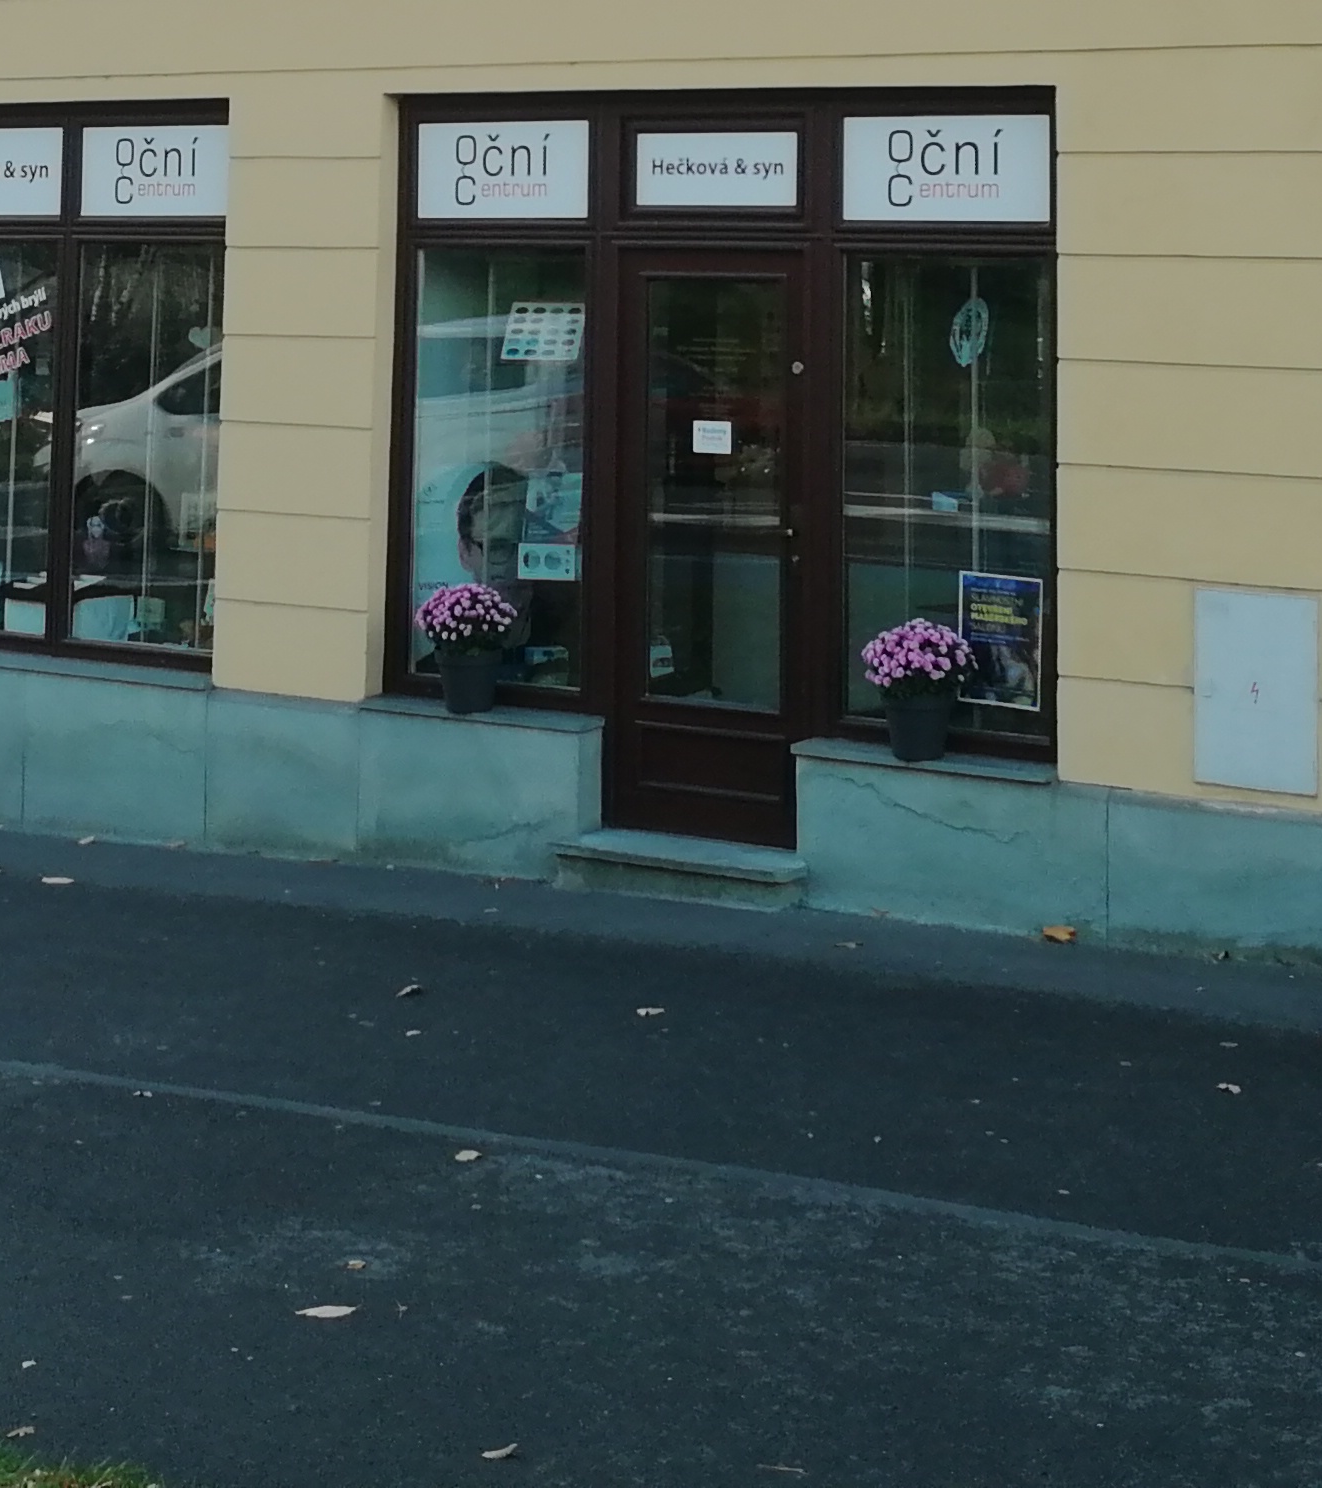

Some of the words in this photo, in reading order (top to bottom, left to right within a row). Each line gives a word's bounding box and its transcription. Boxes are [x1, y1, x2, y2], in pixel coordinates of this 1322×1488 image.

[115, 136, 199, 178] Oční
[455, 133, 550, 177] Oční
[651, 157, 728, 175] Hečková
[734, 158, 747, 174] &
[753, 162, 784, 180] syn
[888, 128, 1004, 176] Oční
[3, 160, 16, 179] &
[20, 164, 49, 184] syn
[21, 286, 47, 309] brýlí
